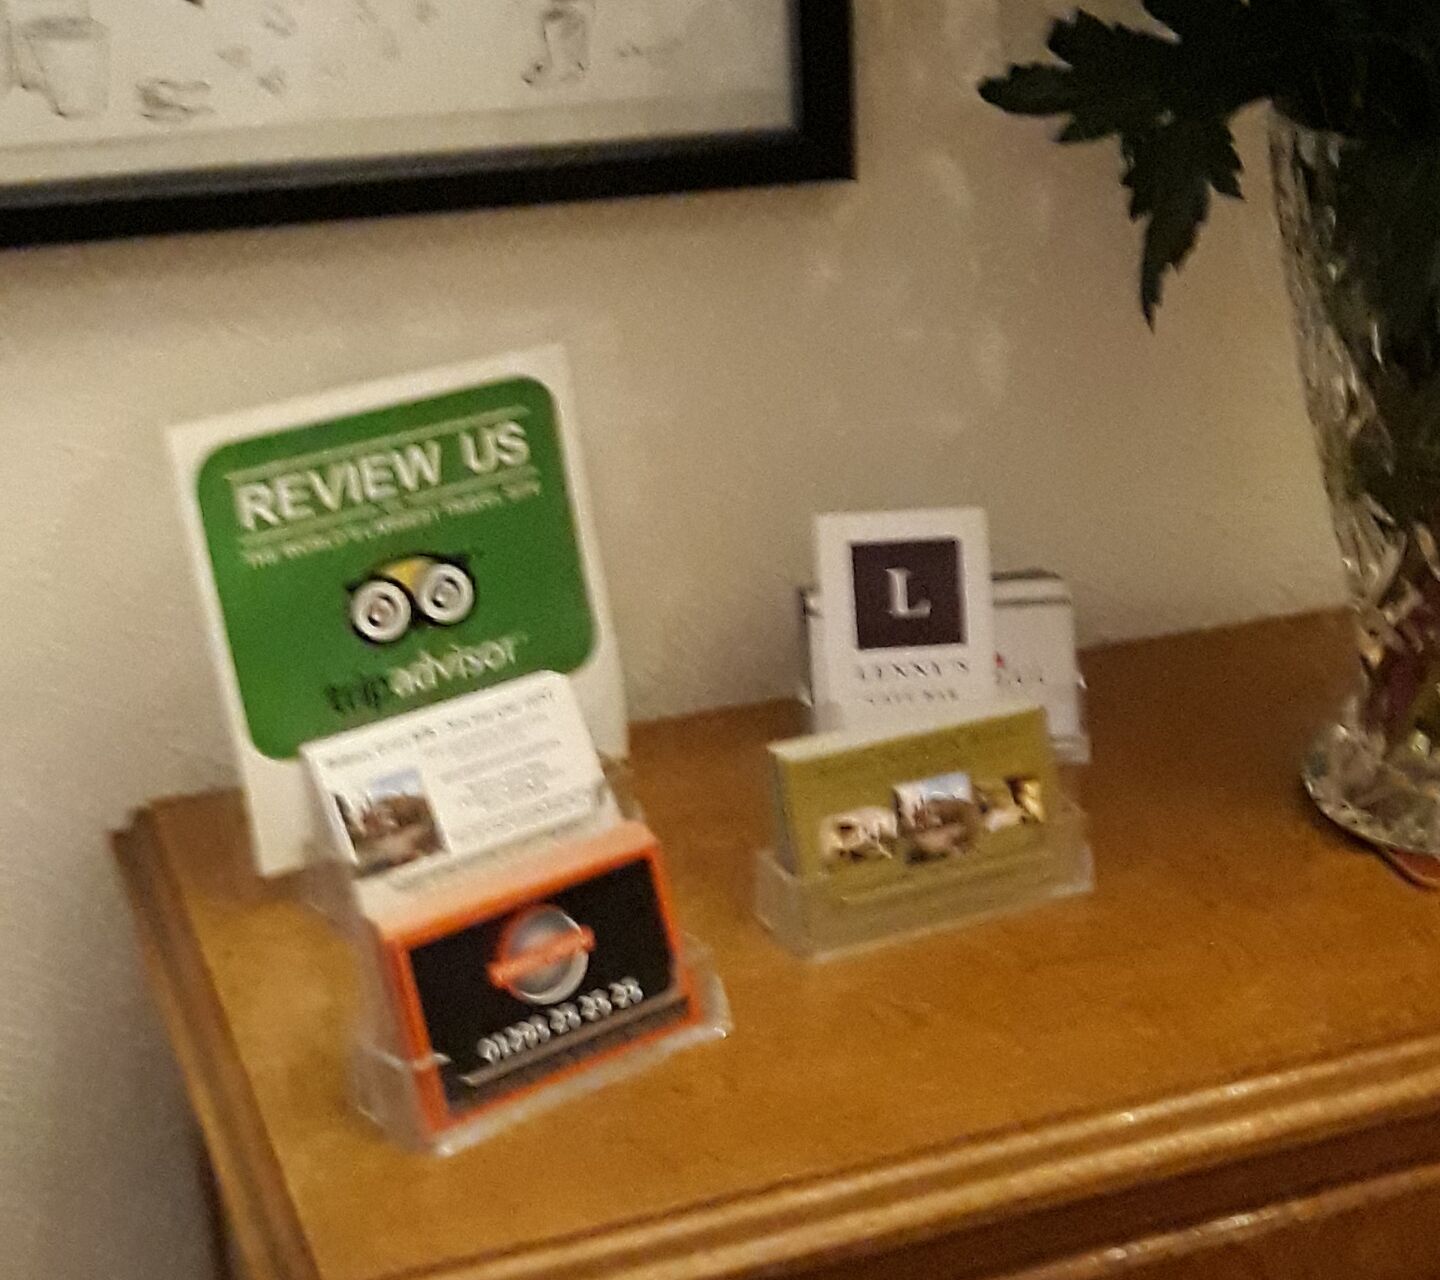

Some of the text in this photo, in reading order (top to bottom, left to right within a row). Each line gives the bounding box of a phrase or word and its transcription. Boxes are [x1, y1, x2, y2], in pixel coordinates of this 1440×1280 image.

[236, 420, 530, 531] REVIEW US
[885, 567, 932, 618] L
[323, 637, 519, 714] tripadvisor
